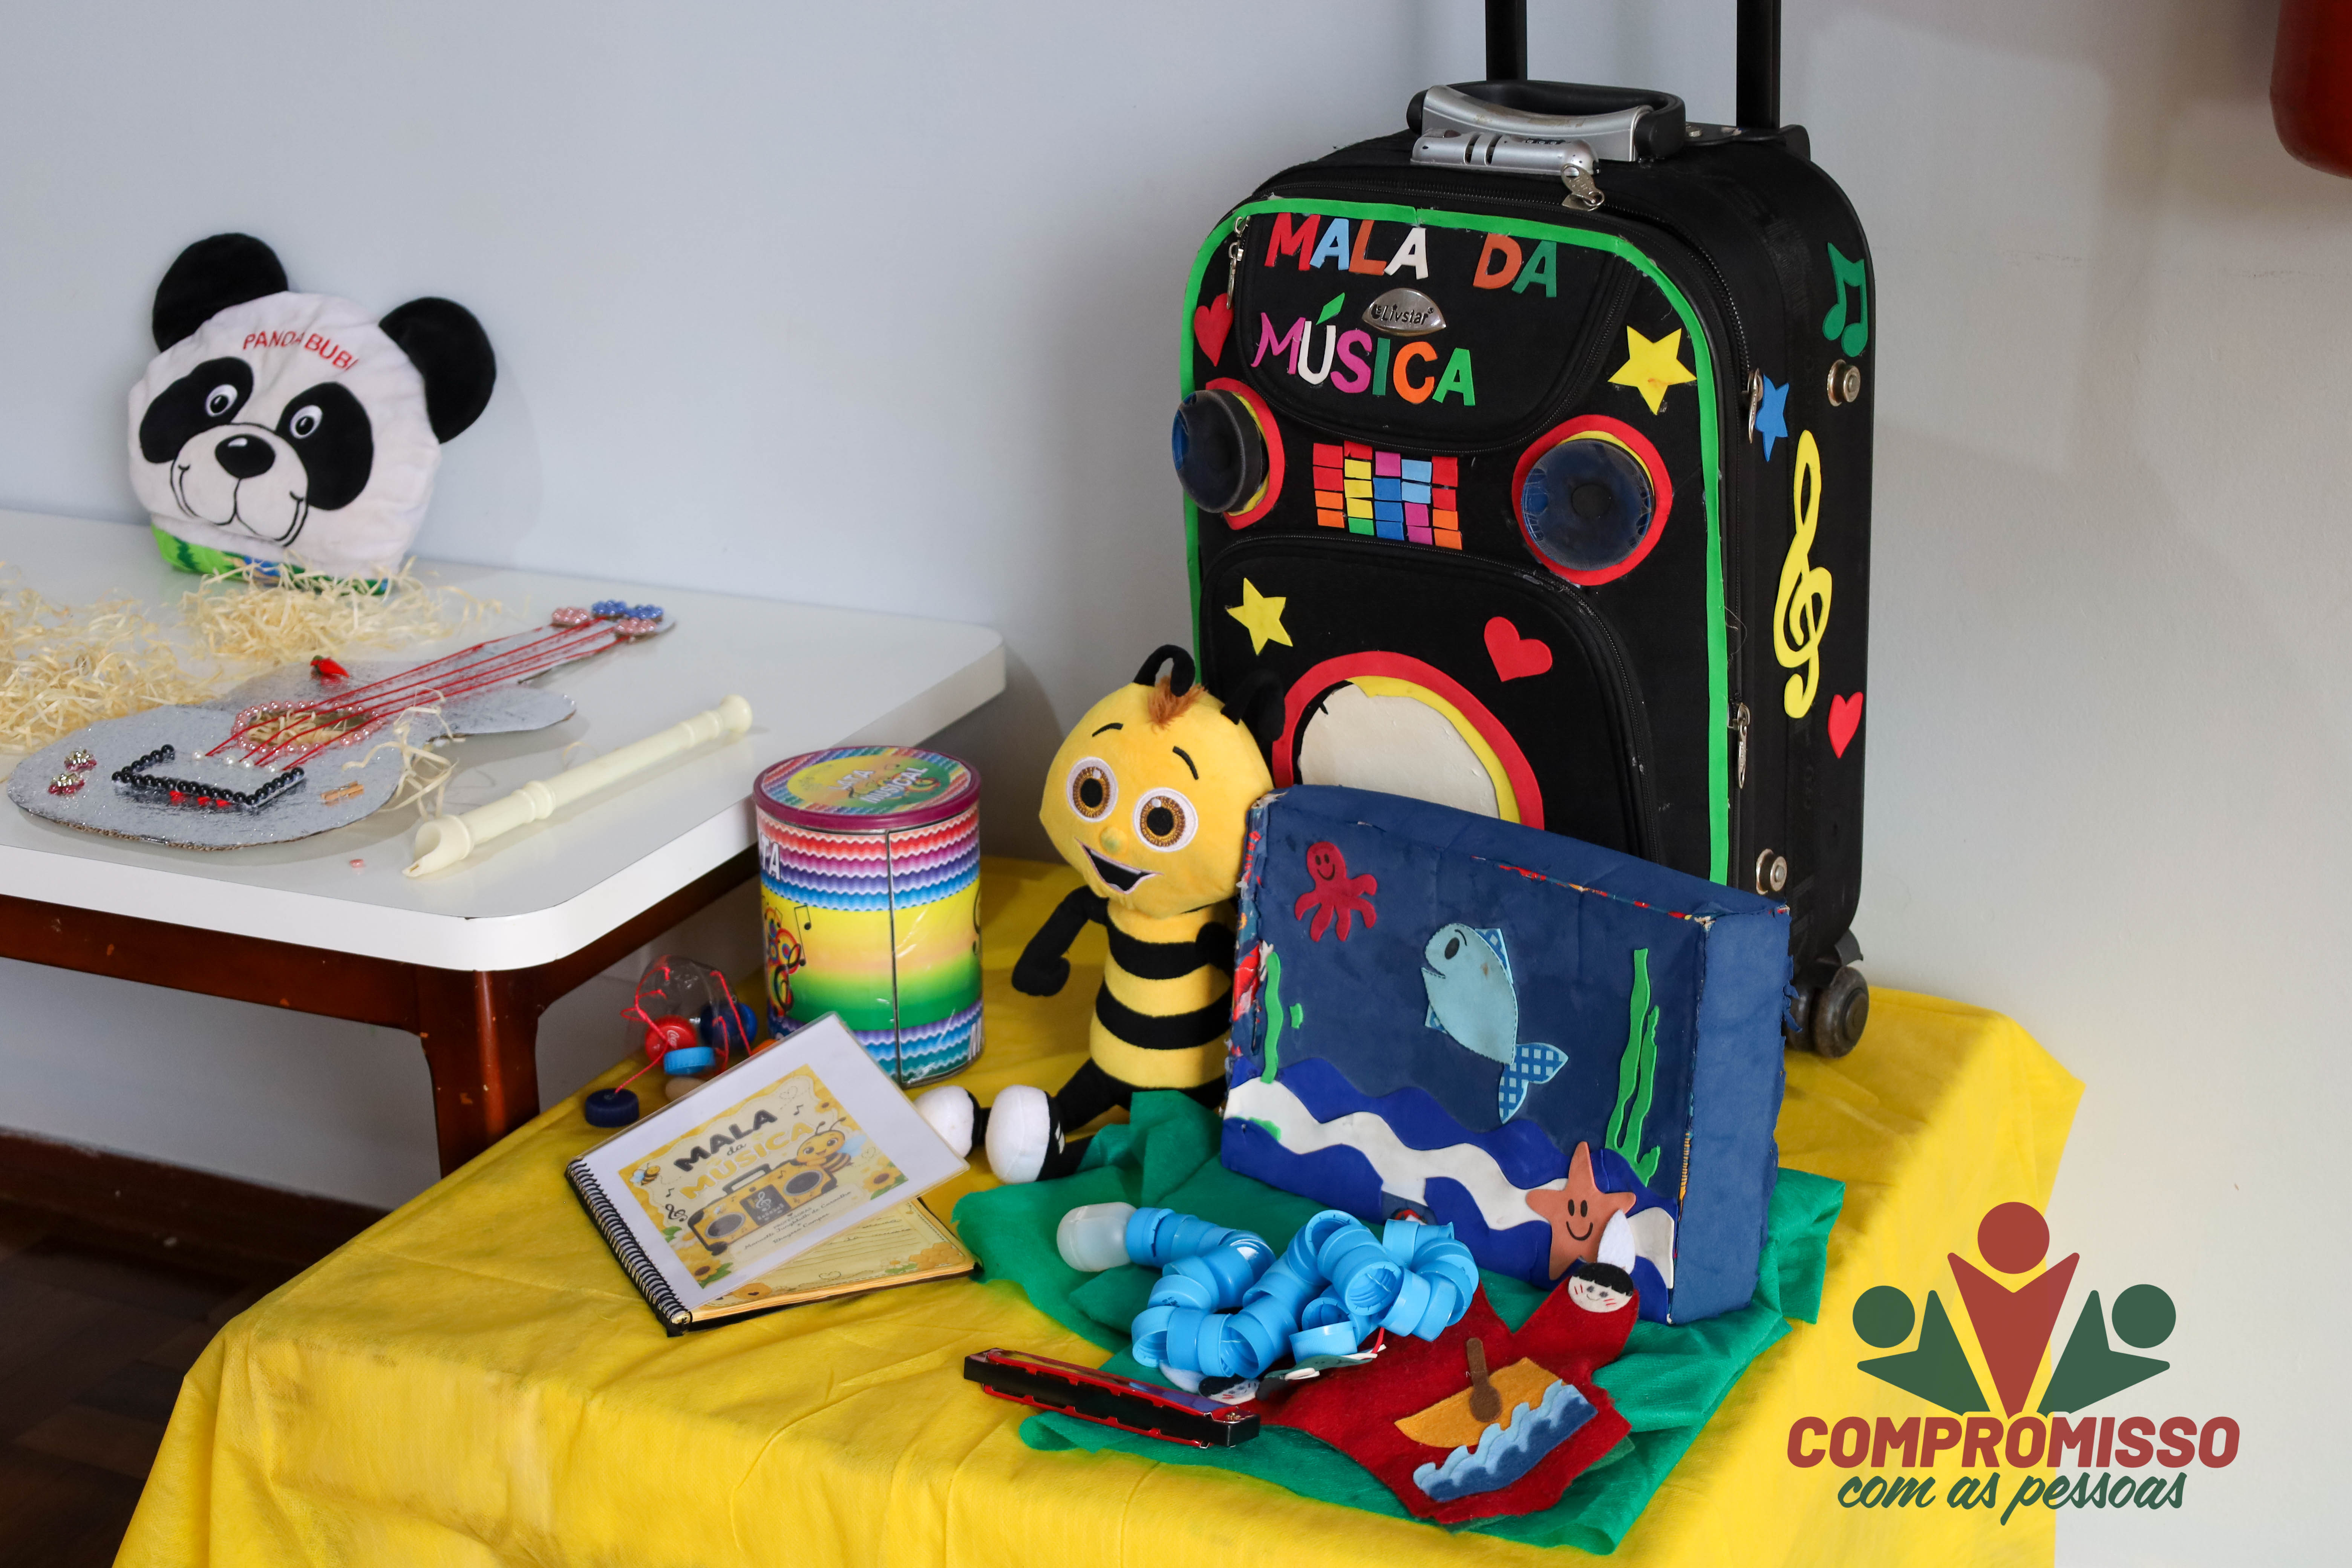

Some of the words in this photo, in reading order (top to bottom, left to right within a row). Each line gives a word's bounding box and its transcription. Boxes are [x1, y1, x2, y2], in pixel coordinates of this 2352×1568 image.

[1264, 212, 1429, 280] MALA
[1473, 233, 1557, 298] DA
[242, 330, 305, 351] PANDA
[305, 333, 359, 371] BUBI
[1250, 292, 1476, 406] MÚSICA
[828, 770, 876, 790] LATA
[859, 767, 929, 804] MUSICAL
[673, 1109, 778, 1172] MALA
[727, 1143, 747, 1156] da
